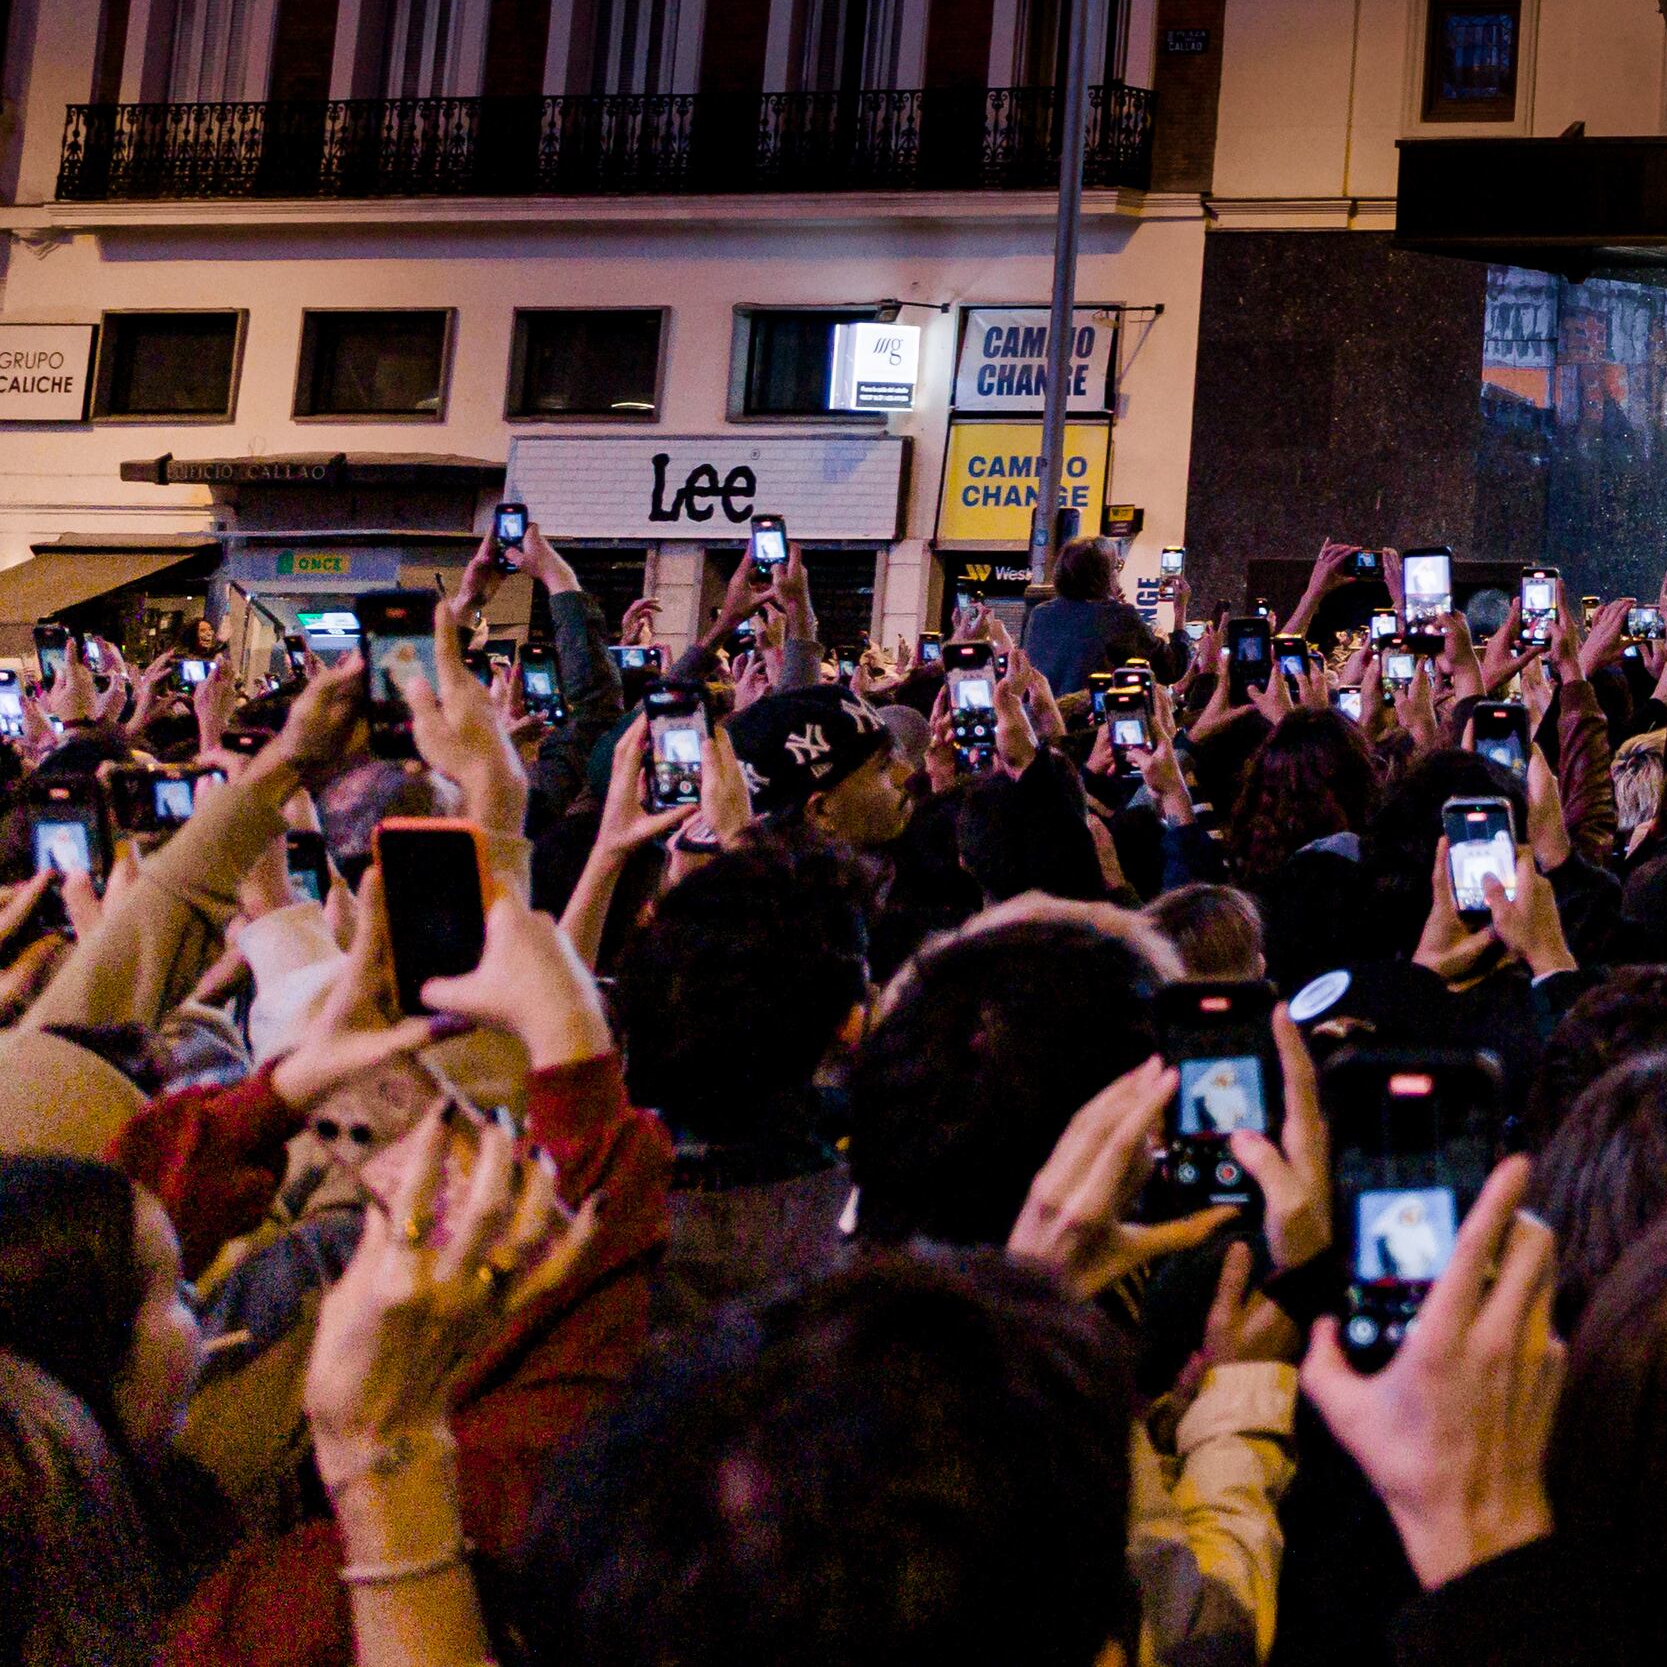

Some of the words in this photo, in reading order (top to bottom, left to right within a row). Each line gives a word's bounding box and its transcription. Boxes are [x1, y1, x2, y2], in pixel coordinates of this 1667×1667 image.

[982, 326, 1096, 359] CAMO
[0, 351, 64, 370] GRUPO
[248, 464, 326, 480] CALLAO
[967, 455, 1088, 479] CAMO
[648, 452, 757, 523] Lee
[299, 557, 343, 572] ONCE
